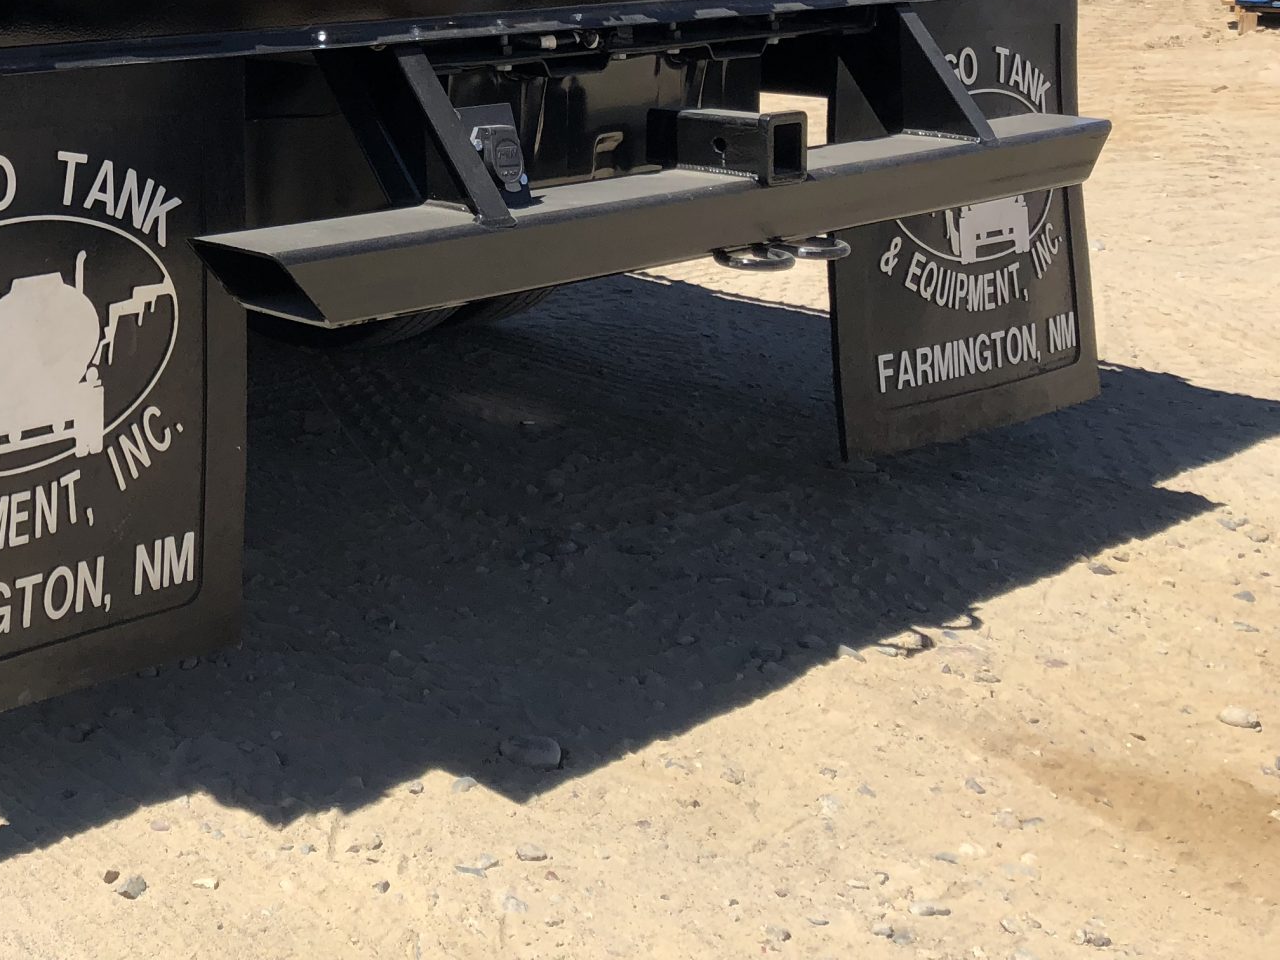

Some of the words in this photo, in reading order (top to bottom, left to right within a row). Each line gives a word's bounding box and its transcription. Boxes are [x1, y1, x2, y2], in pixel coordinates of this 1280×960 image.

[994, 45, 1051, 113] TANK
[57, 151, 182, 246] TANK
[880, 236, 902, 277] &
[905, 252, 1029, 312] EQUIPMENT,
[1031, 222, 1063, 279] INC.
[877, 322, 1041, 393] FARMINGTON,
[1048, 311, 1077, 353] NM
[107, 405, 184, 491] INC.
[134, 532, 195, 595] NM
